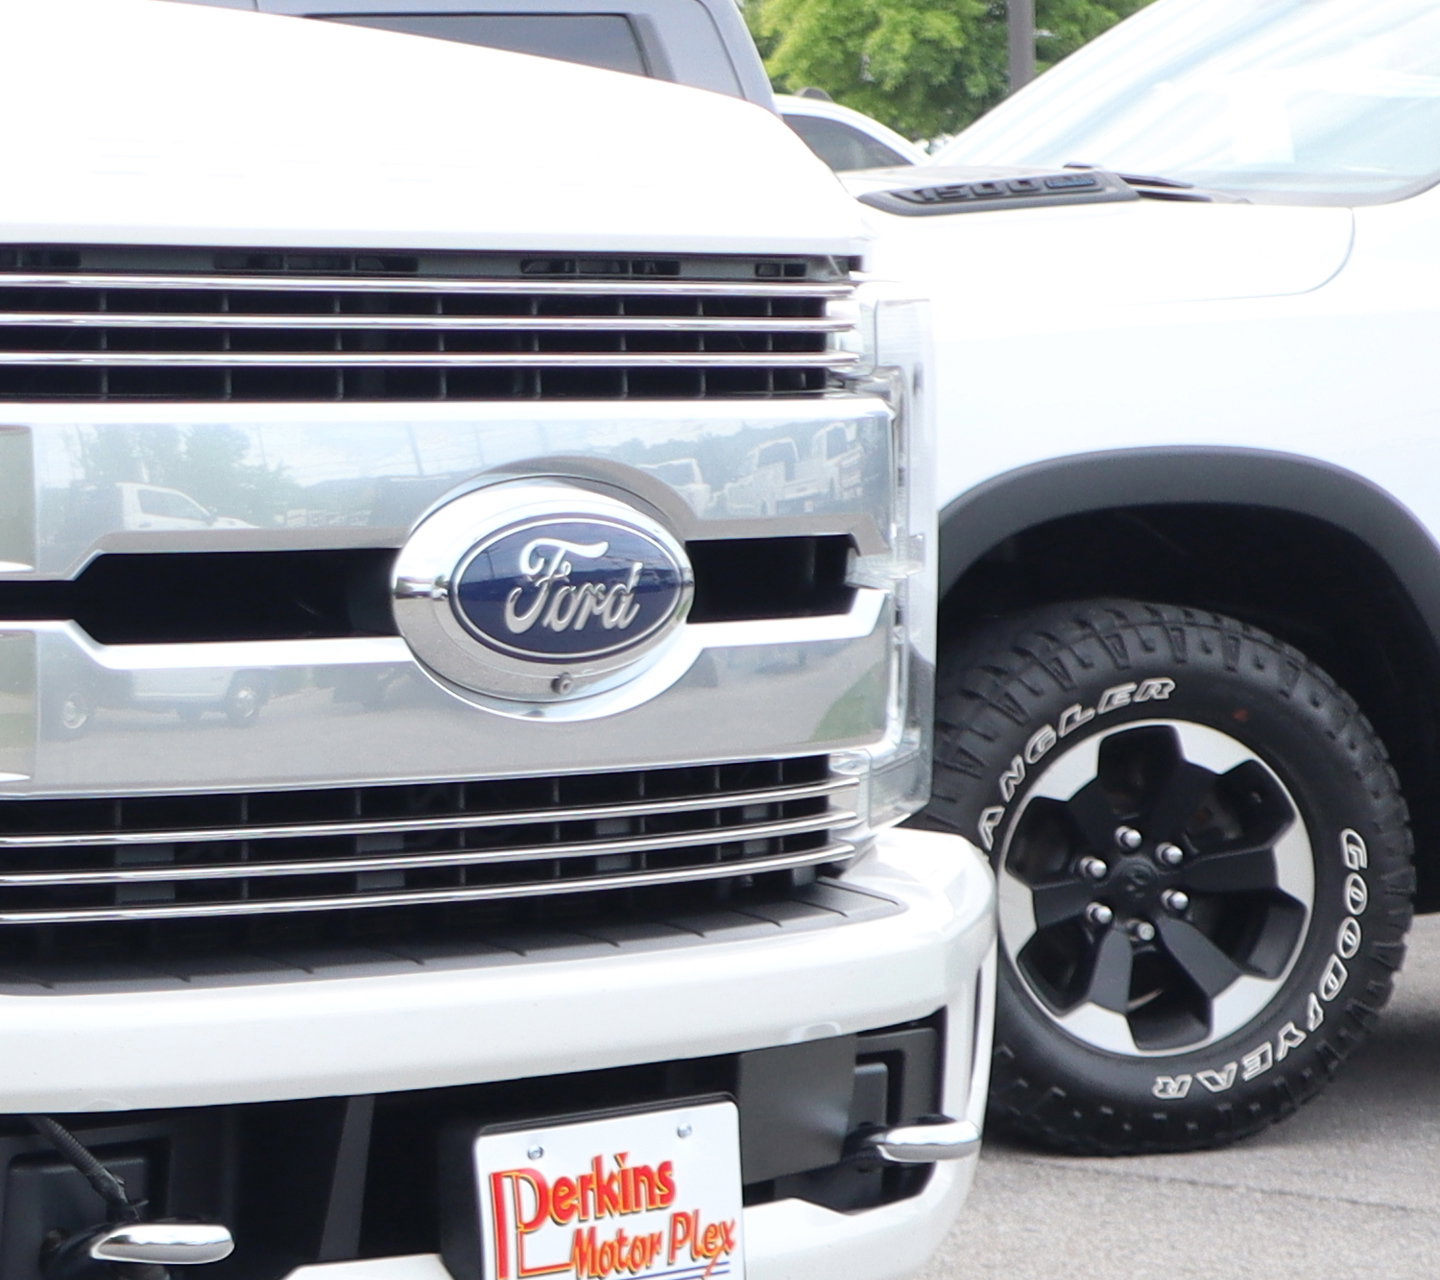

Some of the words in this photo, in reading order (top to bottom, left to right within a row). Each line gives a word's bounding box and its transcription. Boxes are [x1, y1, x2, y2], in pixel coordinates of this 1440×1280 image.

[505, 537, 643, 634] Ford
[978, 677, 1176, 852] ANGLER
[1152, 827, 1369, 1100] GOODYEAR
[568, 1225, 663, 1280] Motor
[667, 1208, 736, 1280] Plex
